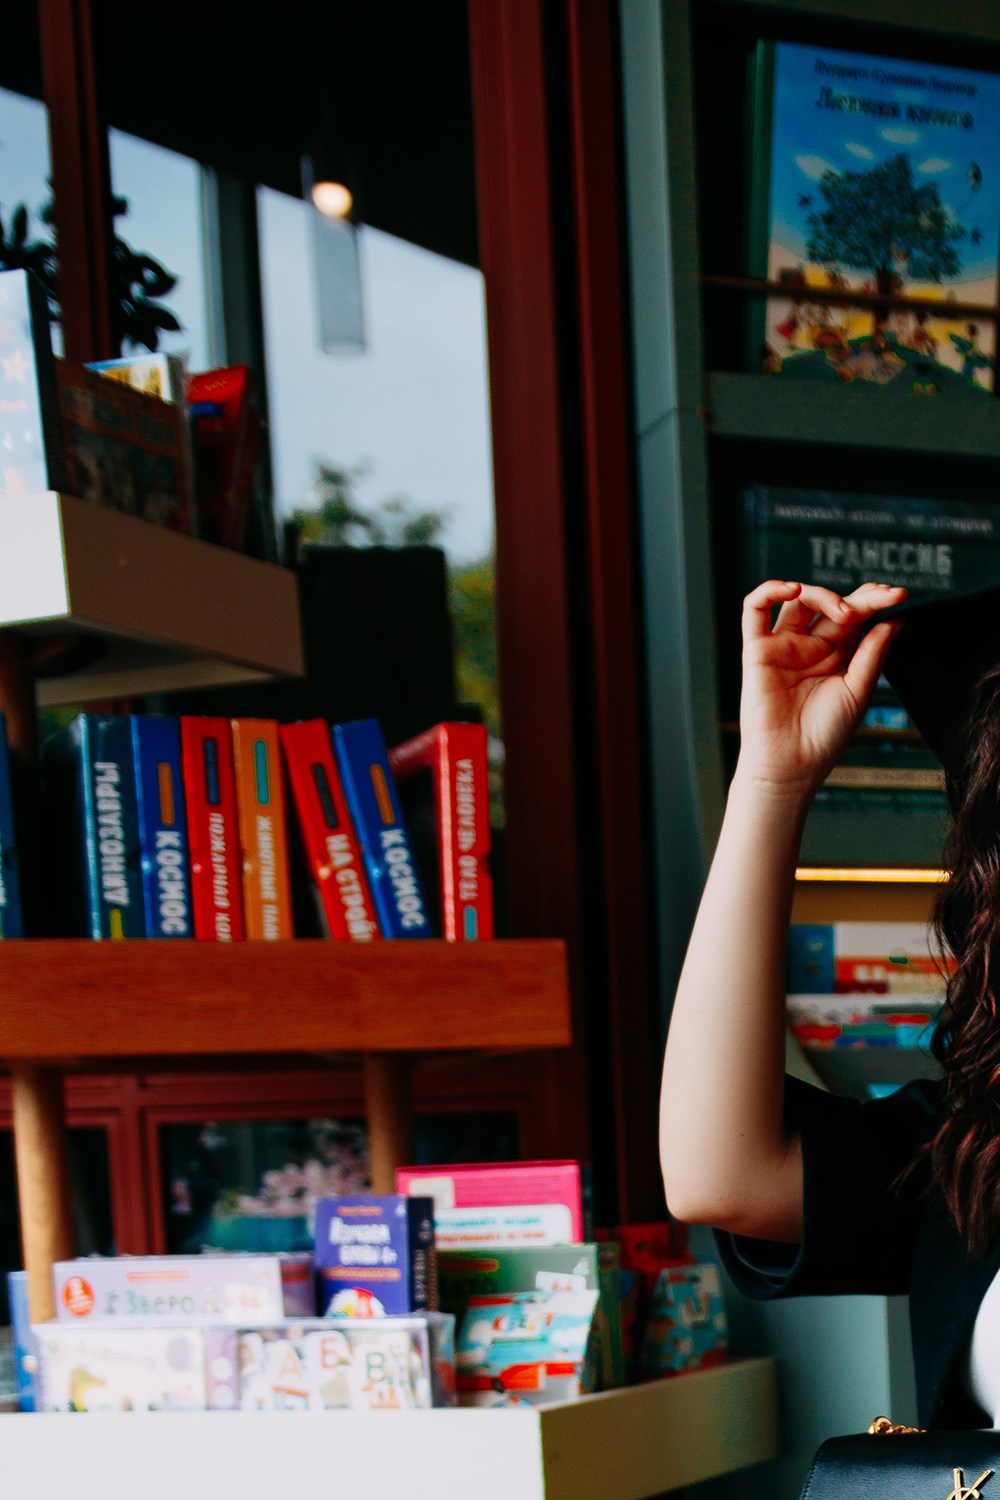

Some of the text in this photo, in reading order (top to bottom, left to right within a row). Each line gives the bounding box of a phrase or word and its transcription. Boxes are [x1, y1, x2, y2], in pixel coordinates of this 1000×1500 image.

[94, 761, 130, 907] ДИНОЗАВРЫ
[155, 830, 188, 935] КОСМОС
[380, 828, 425, 929] КОСМОС
